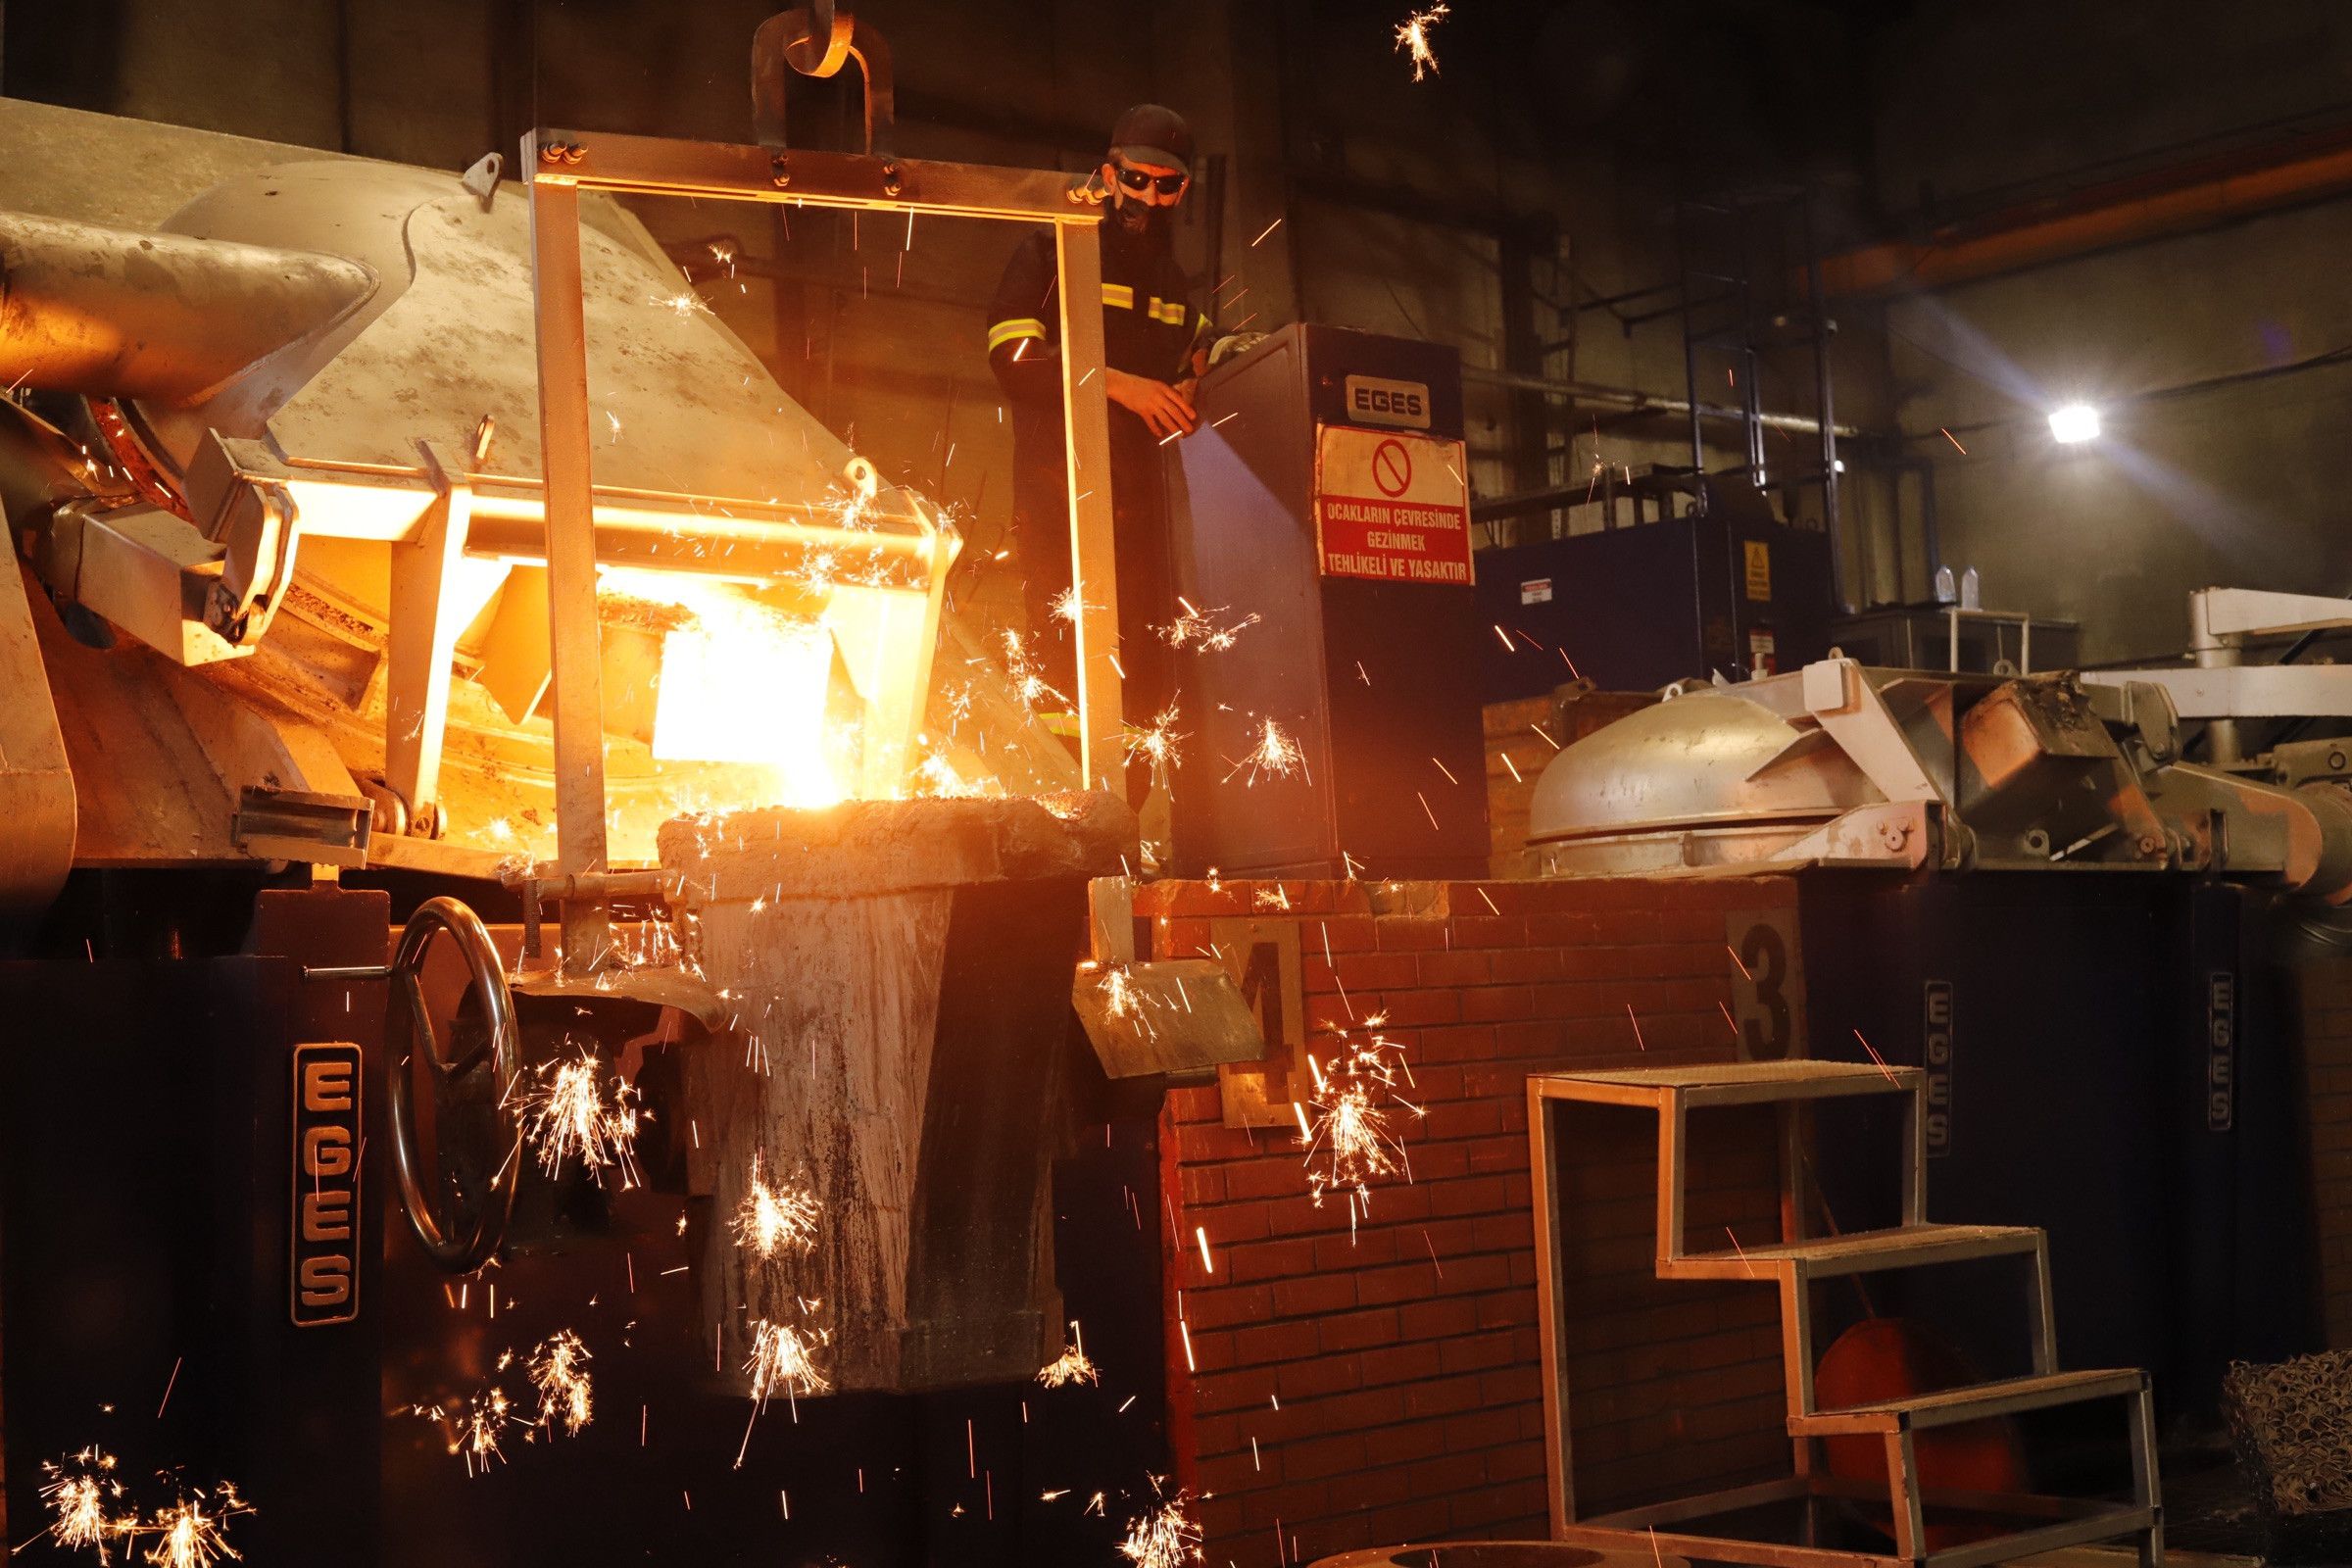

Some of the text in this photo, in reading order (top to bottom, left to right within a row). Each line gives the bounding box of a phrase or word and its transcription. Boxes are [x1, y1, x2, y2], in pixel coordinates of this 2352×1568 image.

[1354, 387, 1422, 416] EGES
[1327, 502, 1461, 530] OCAKLARIN ÇEVRESİNDE
[1367, 529, 1426, 552] GEZİNMEK
[1328, 552, 1467, 581] TEHLİKELİ VE YASAKTIR
[1741, 923, 1791, 1060] 3
[1927, 992, 1951, 1147] EGES
[2211, 981, 2232, 1120] EGES
[301, 1061, 352, 1307] EGES
